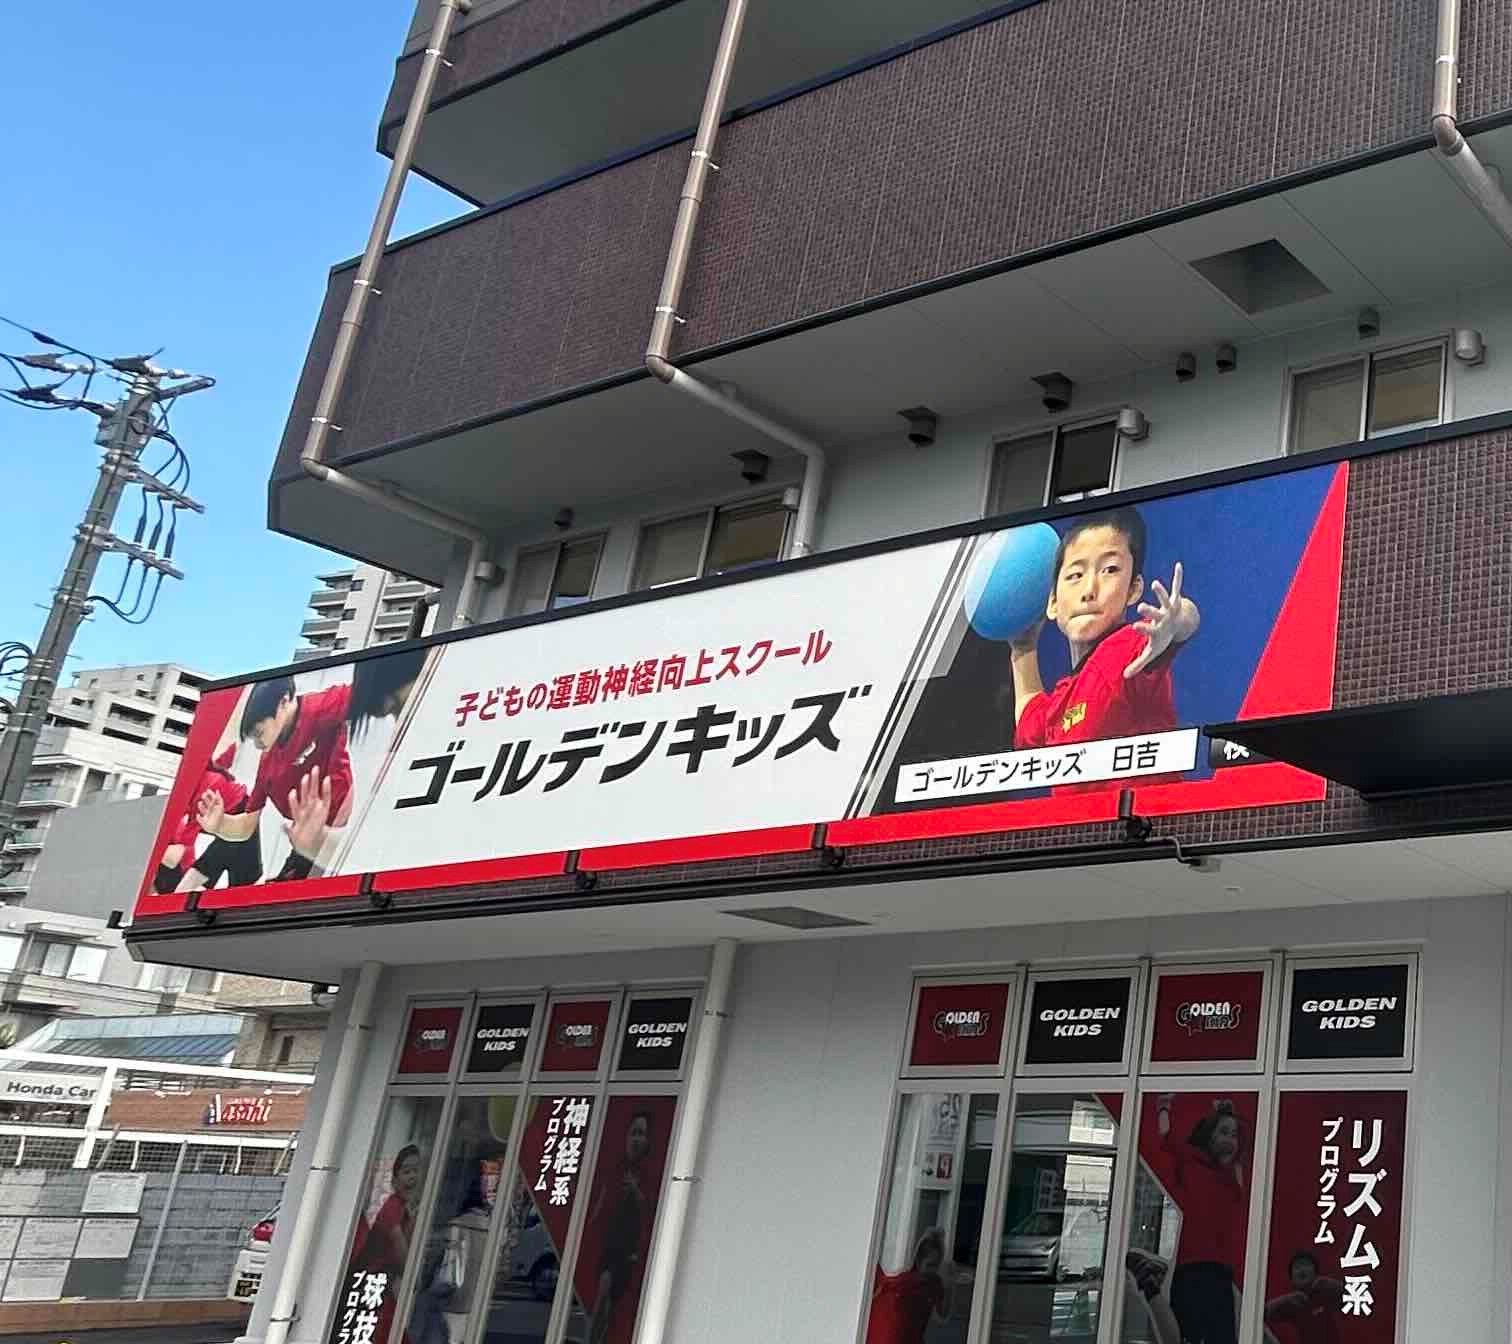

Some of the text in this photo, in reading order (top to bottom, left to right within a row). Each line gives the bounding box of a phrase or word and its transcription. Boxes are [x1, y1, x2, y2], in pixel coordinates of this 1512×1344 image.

[455, 630, 832, 727] 子どもの運動神経向上スクール
[394, 684, 873, 809] ゴールデンキッズ
[912, 741, 1161, 793] ゴールデンキッズ 日吉
[1302, 996, 1397, 1013] GOLDEN
[1040, 1007, 1120, 1021] GOLDEN
[628, 1022, 687, 1034] GOLDEN
[1053, 1024, 1102, 1037] KIDS
[1319, 1015, 1376, 1030] KIDS
[477, 1027, 529, 1039] GOLDEN
[484, 1040, 516, 1052] KIDS
[636, 1037, 673, 1048] KIDS
[7, 1081, 63, 1095] Honda
[534, 1097, 565, 1191] プログラム
[549, 1098, 590, 1206] 神経系
[1314, 1116, 1344, 1244] プログラム
[1340, 1118, 1386, 1316] リズム系
